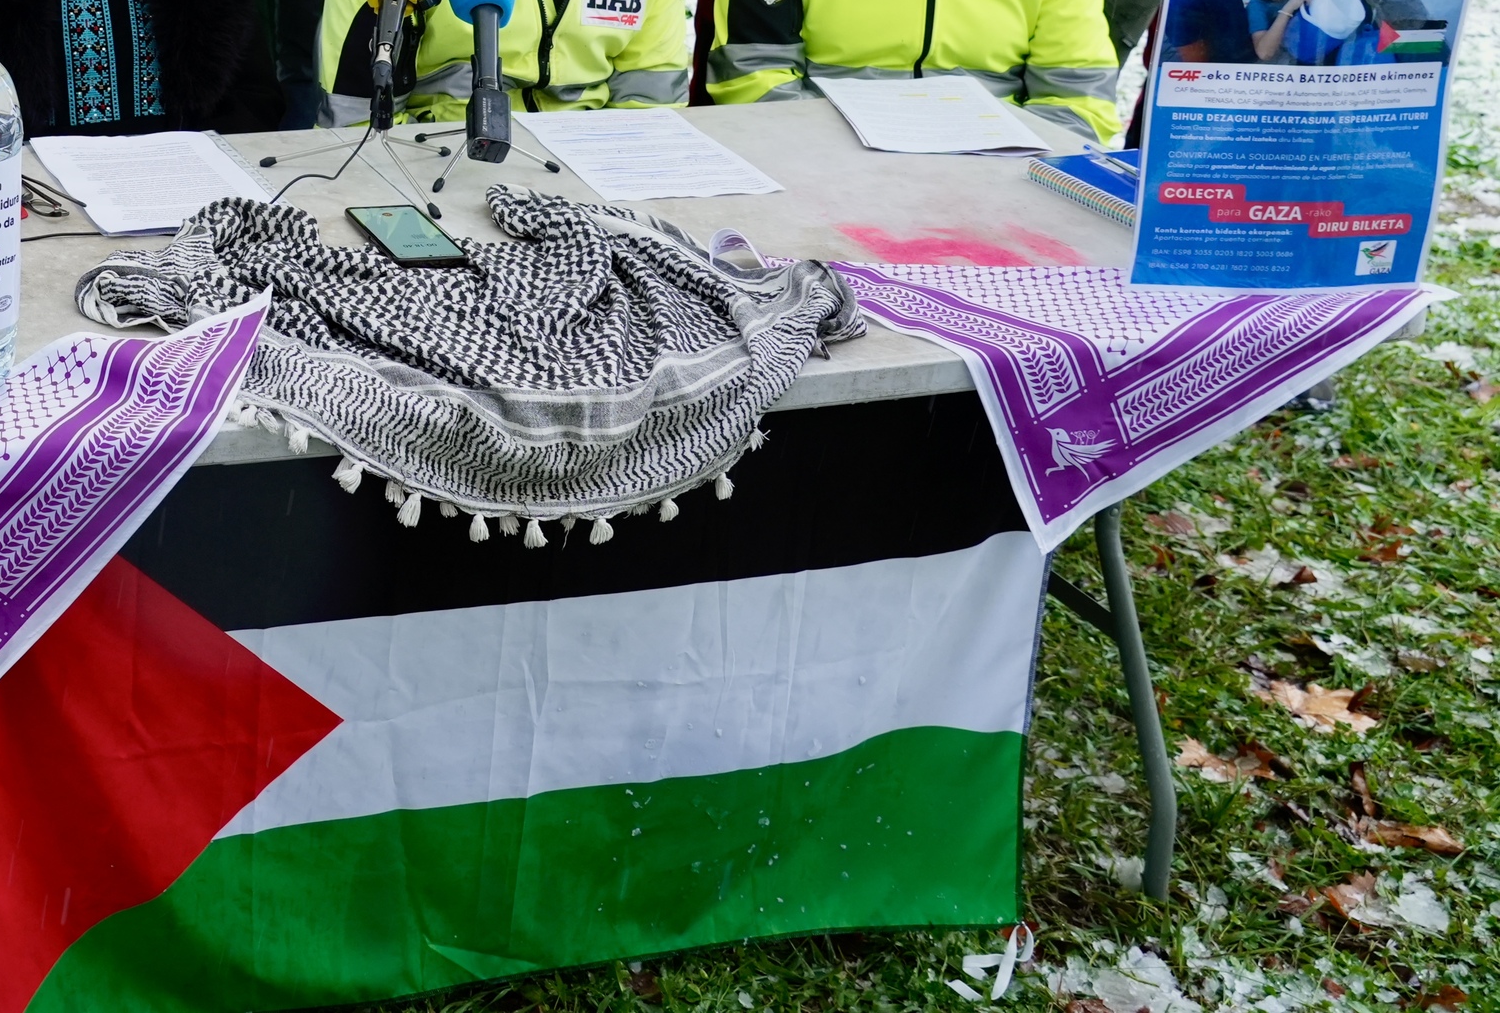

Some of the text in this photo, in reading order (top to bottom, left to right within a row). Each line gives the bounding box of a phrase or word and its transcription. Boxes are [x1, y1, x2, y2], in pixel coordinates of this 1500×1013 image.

[1235, 71, 1294, 83] ENPRESA
[1299, 71, 1377, 84] BATZORDEEN
[1381, 70, 1435, 81] ekimenez
[1171, 112, 1429, 125] BIHUR DEZAGUN ELKARTASUNA ESPERANTZA ITURRI
[1168, 151, 1234, 160] CONVIRTAMOS
[1236, 152, 1246, 160] LA
[1249, 153, 1307, 161] SOLIDARIDAD
[1322, 153, 1352, 161] FUENTE
[1354, 153, 1364, 161] DE
[1367, 151, 1411, 160] ESPERANZA
[1164, 187, 1234, 200] COLECTA
[1216, 208, 1242, 218] para
[1248, 205, 1303, 221] GAZA
[3, 217, 15, 227] da
[1317, 219, 1405, 233] DIRU BILKETA
